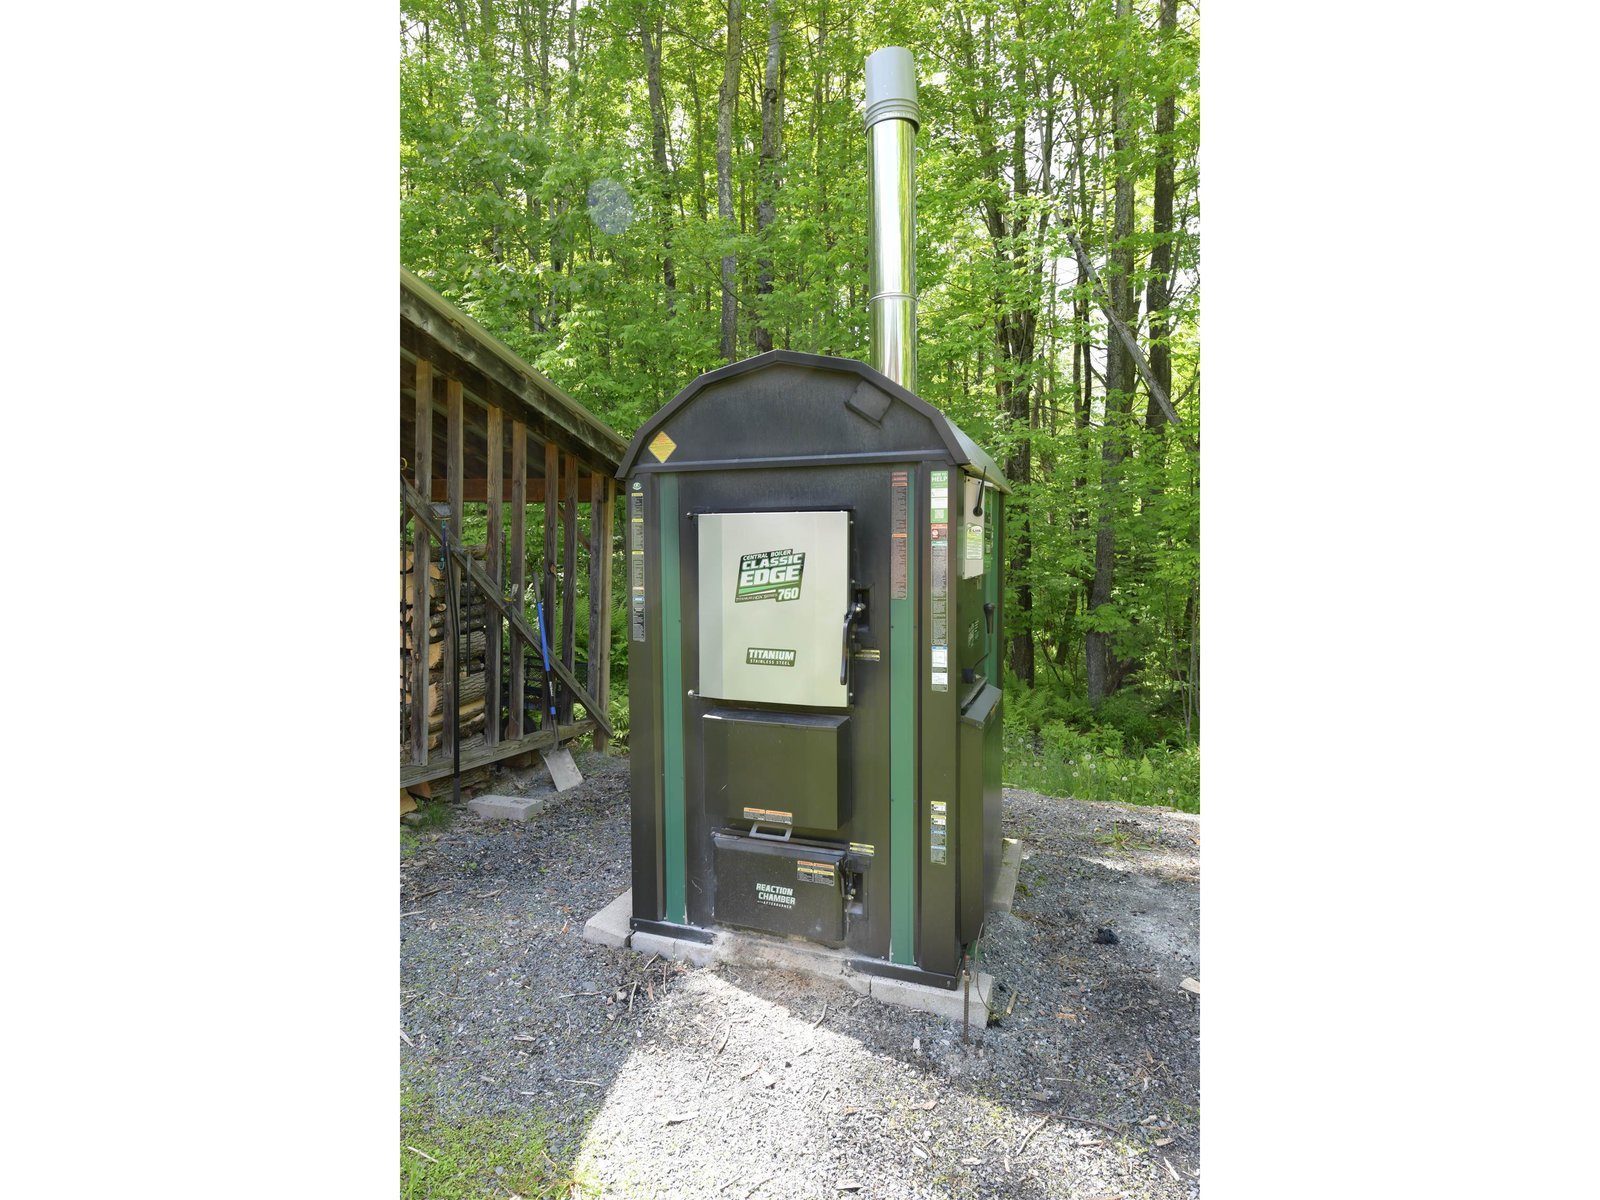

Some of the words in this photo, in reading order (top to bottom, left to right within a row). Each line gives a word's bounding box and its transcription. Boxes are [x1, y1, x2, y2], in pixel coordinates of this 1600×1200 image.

[770, 549, 792, 557] BOILER
[742, 554, 803, 570] CLASSIC
[740, 564, 801, 587] EDGE
[777, 587, 800, 601] 760
[749, 649, 795, 660] TITANIUM
[756, 883, 793, 896] REACTION
[758, 892, 796, 905] CHAMBER
[763, 901, 792, 909] AFTERBURNER
